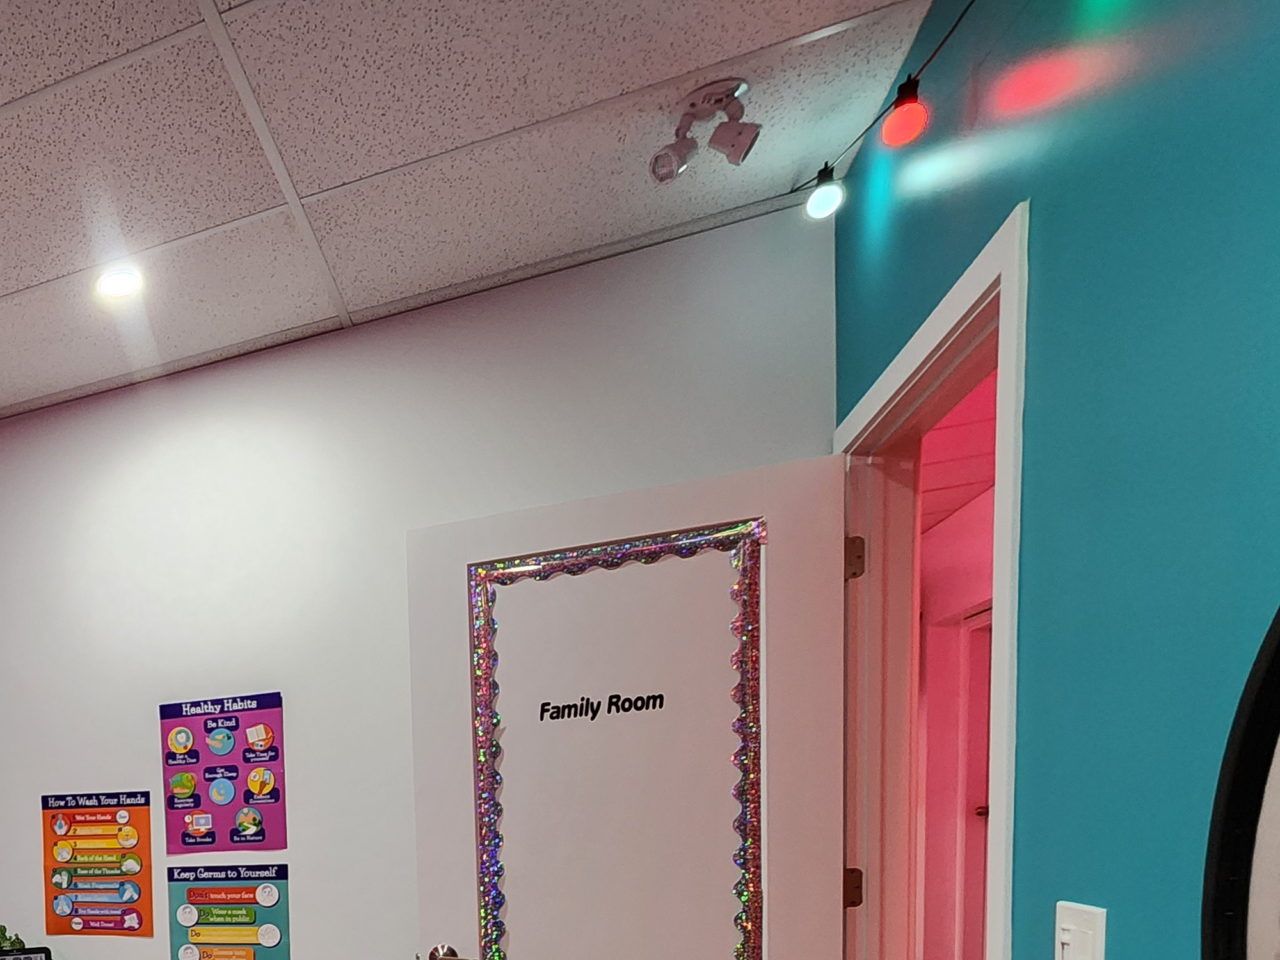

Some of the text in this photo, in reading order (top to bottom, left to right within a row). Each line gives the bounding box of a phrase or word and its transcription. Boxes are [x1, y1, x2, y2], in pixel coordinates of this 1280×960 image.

[182, 698, 257, 715] Healthy Habits
[539, 693, 665, 722] Family Room
[207, 718, 236, 728] Be Kind
[47, 794, 146, 807] How To Wash Your Hands
[173, 867, 278, 880] Keep Germs to Yourself
[189, 890, 209, 899] Don't
[241, 891, 254, 899] face
[200, 910, 209, 918] Do
[190, 929, 200, 937] Do
[202, 951, 212, 959] Do
